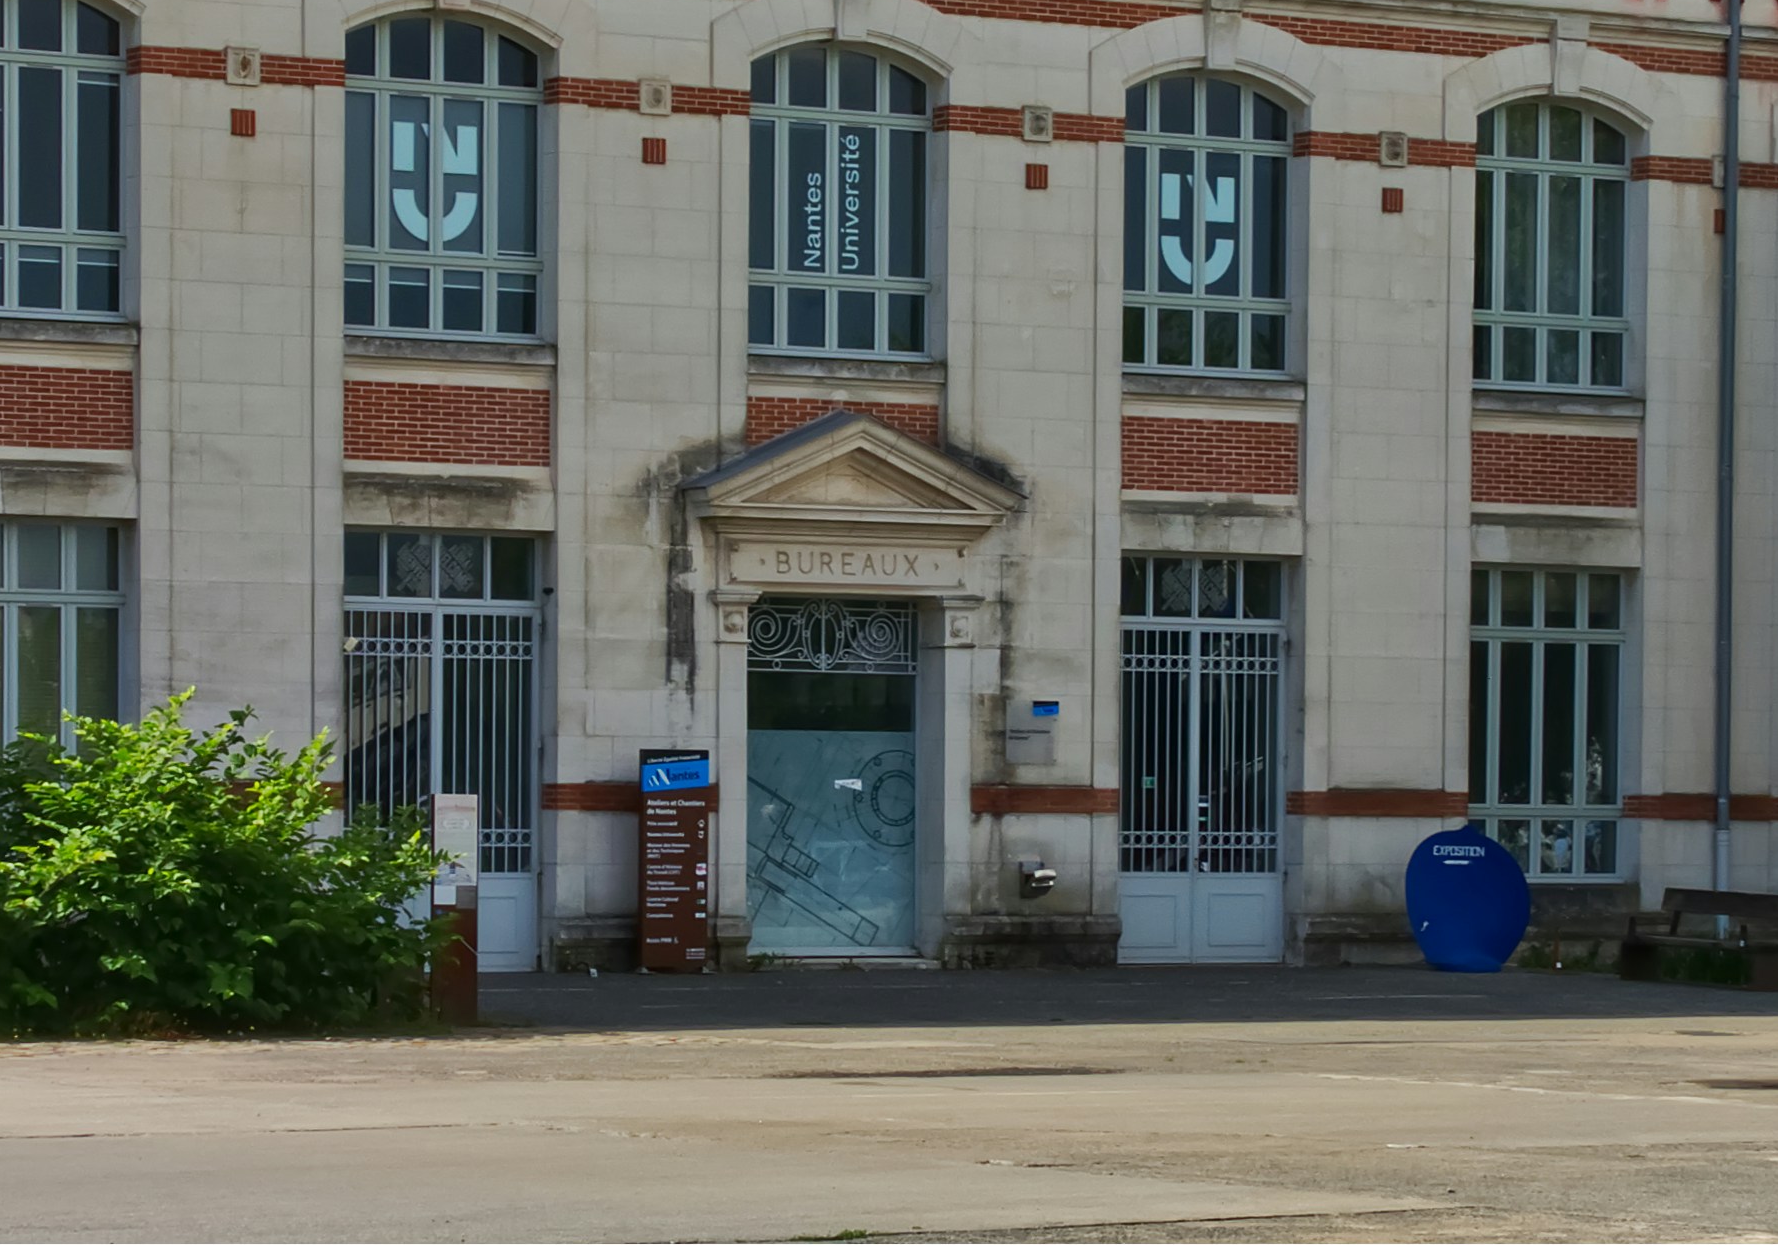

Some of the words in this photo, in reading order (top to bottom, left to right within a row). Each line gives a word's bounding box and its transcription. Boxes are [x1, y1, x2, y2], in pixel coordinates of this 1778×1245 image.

[804, 172, 821, 268] Nantes
[840, 133, 860, 270] Université
[775, 550, 920, 577] BUREAUX
[1432, 845, 1486, 857] EXPOSITION
